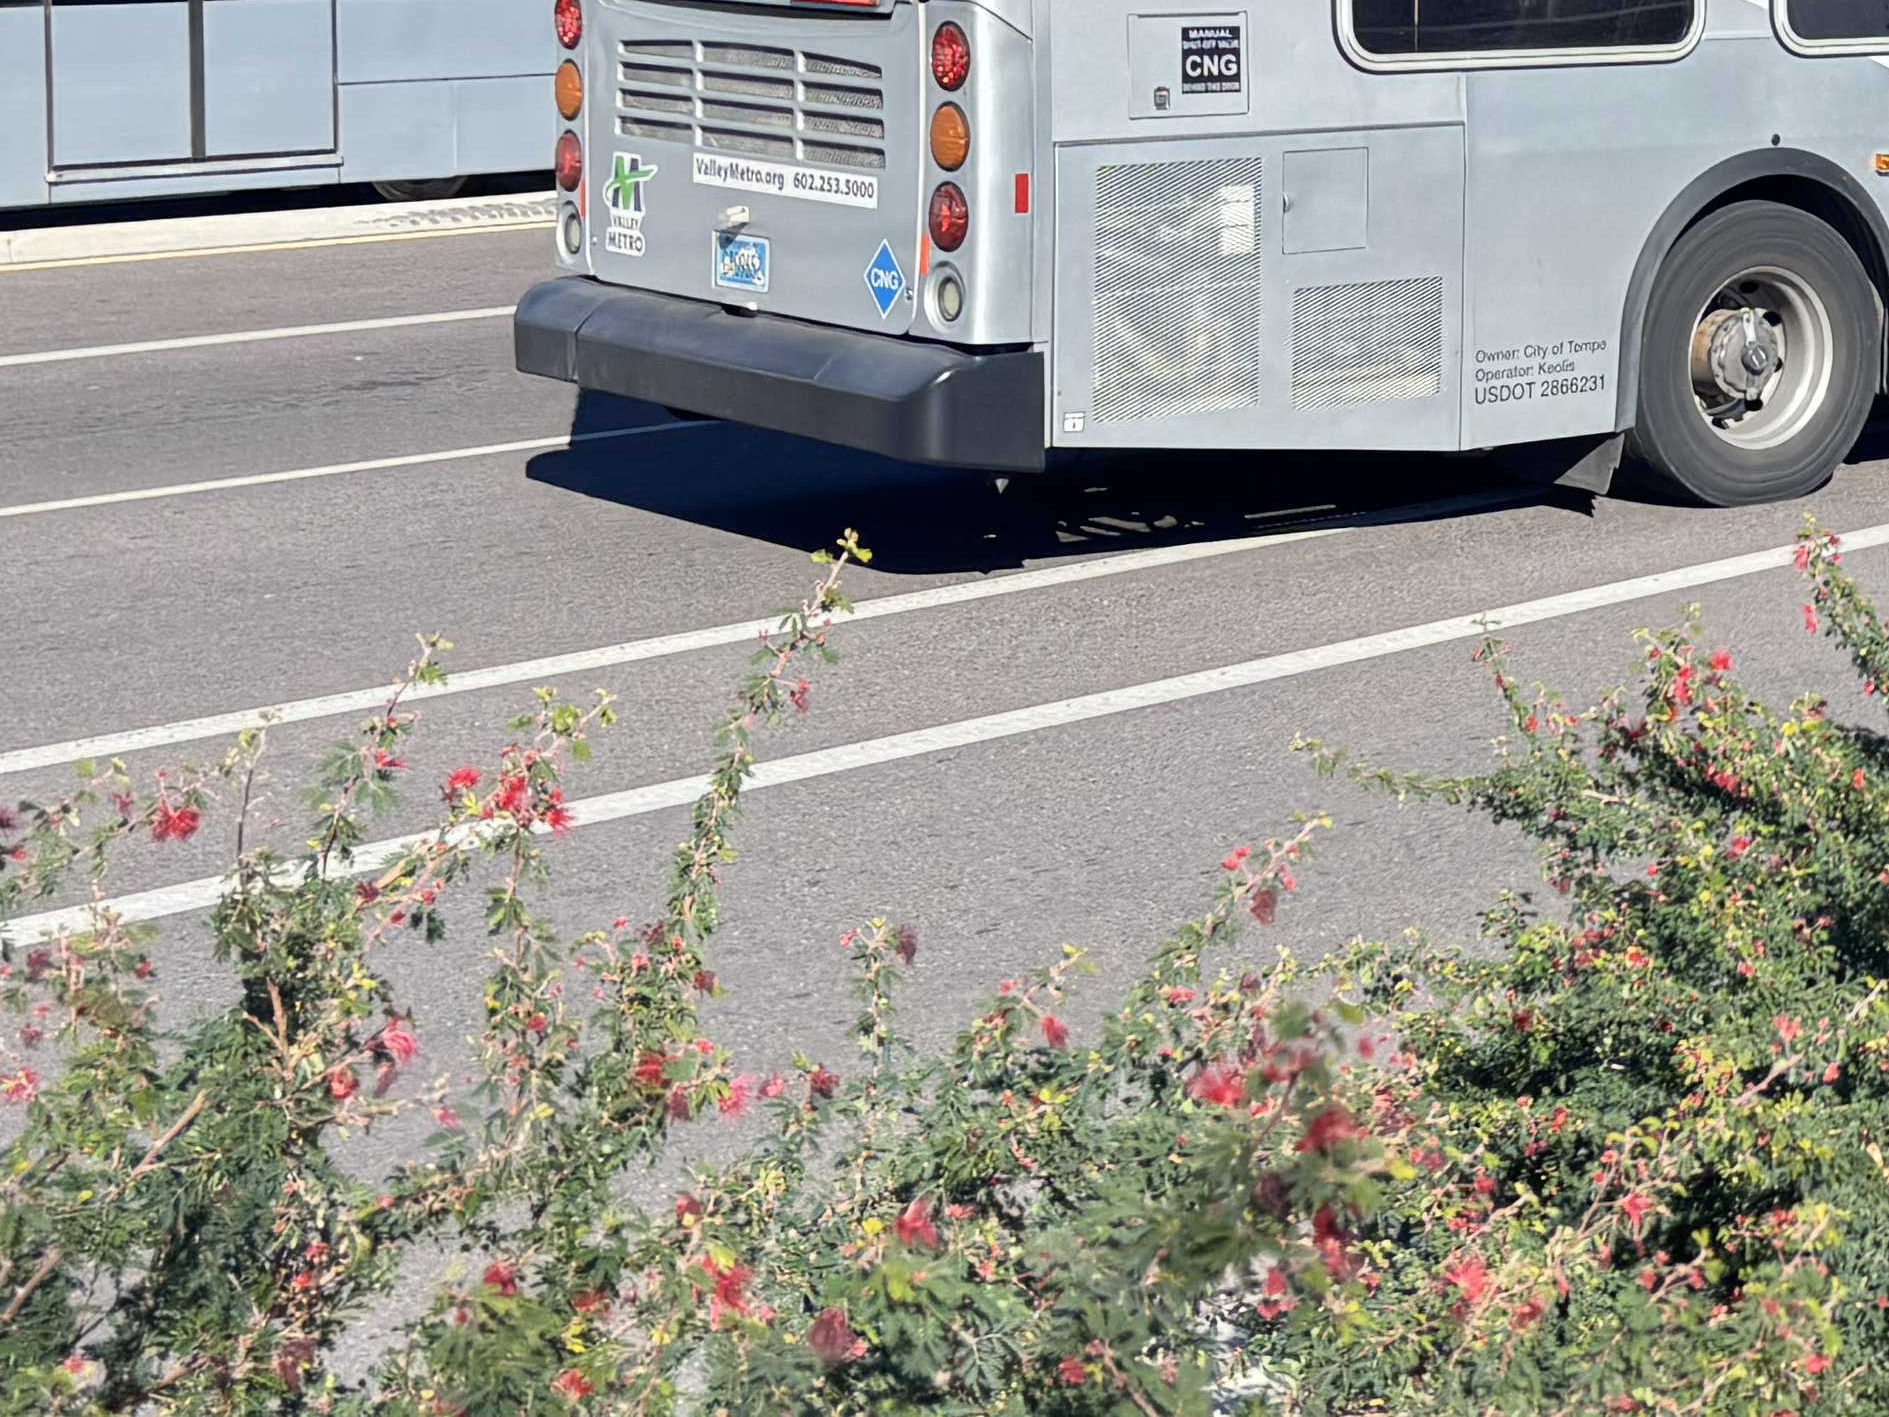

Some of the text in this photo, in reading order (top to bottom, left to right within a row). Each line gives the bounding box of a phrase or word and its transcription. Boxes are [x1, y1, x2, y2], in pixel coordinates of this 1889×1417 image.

[1185, 54, 1239, 77] CNG
[696, 158, 875, 199] ValleyMetro.org 602.253.5000
[869, 267, 900, 291] CNG
[1523, 344, 1549, 360] City
[1551, 342, 1565, 355] of
[1475, 365, 1535, 384] Operator:
[1475, 374, 1606, 405] USDOT 2866231
